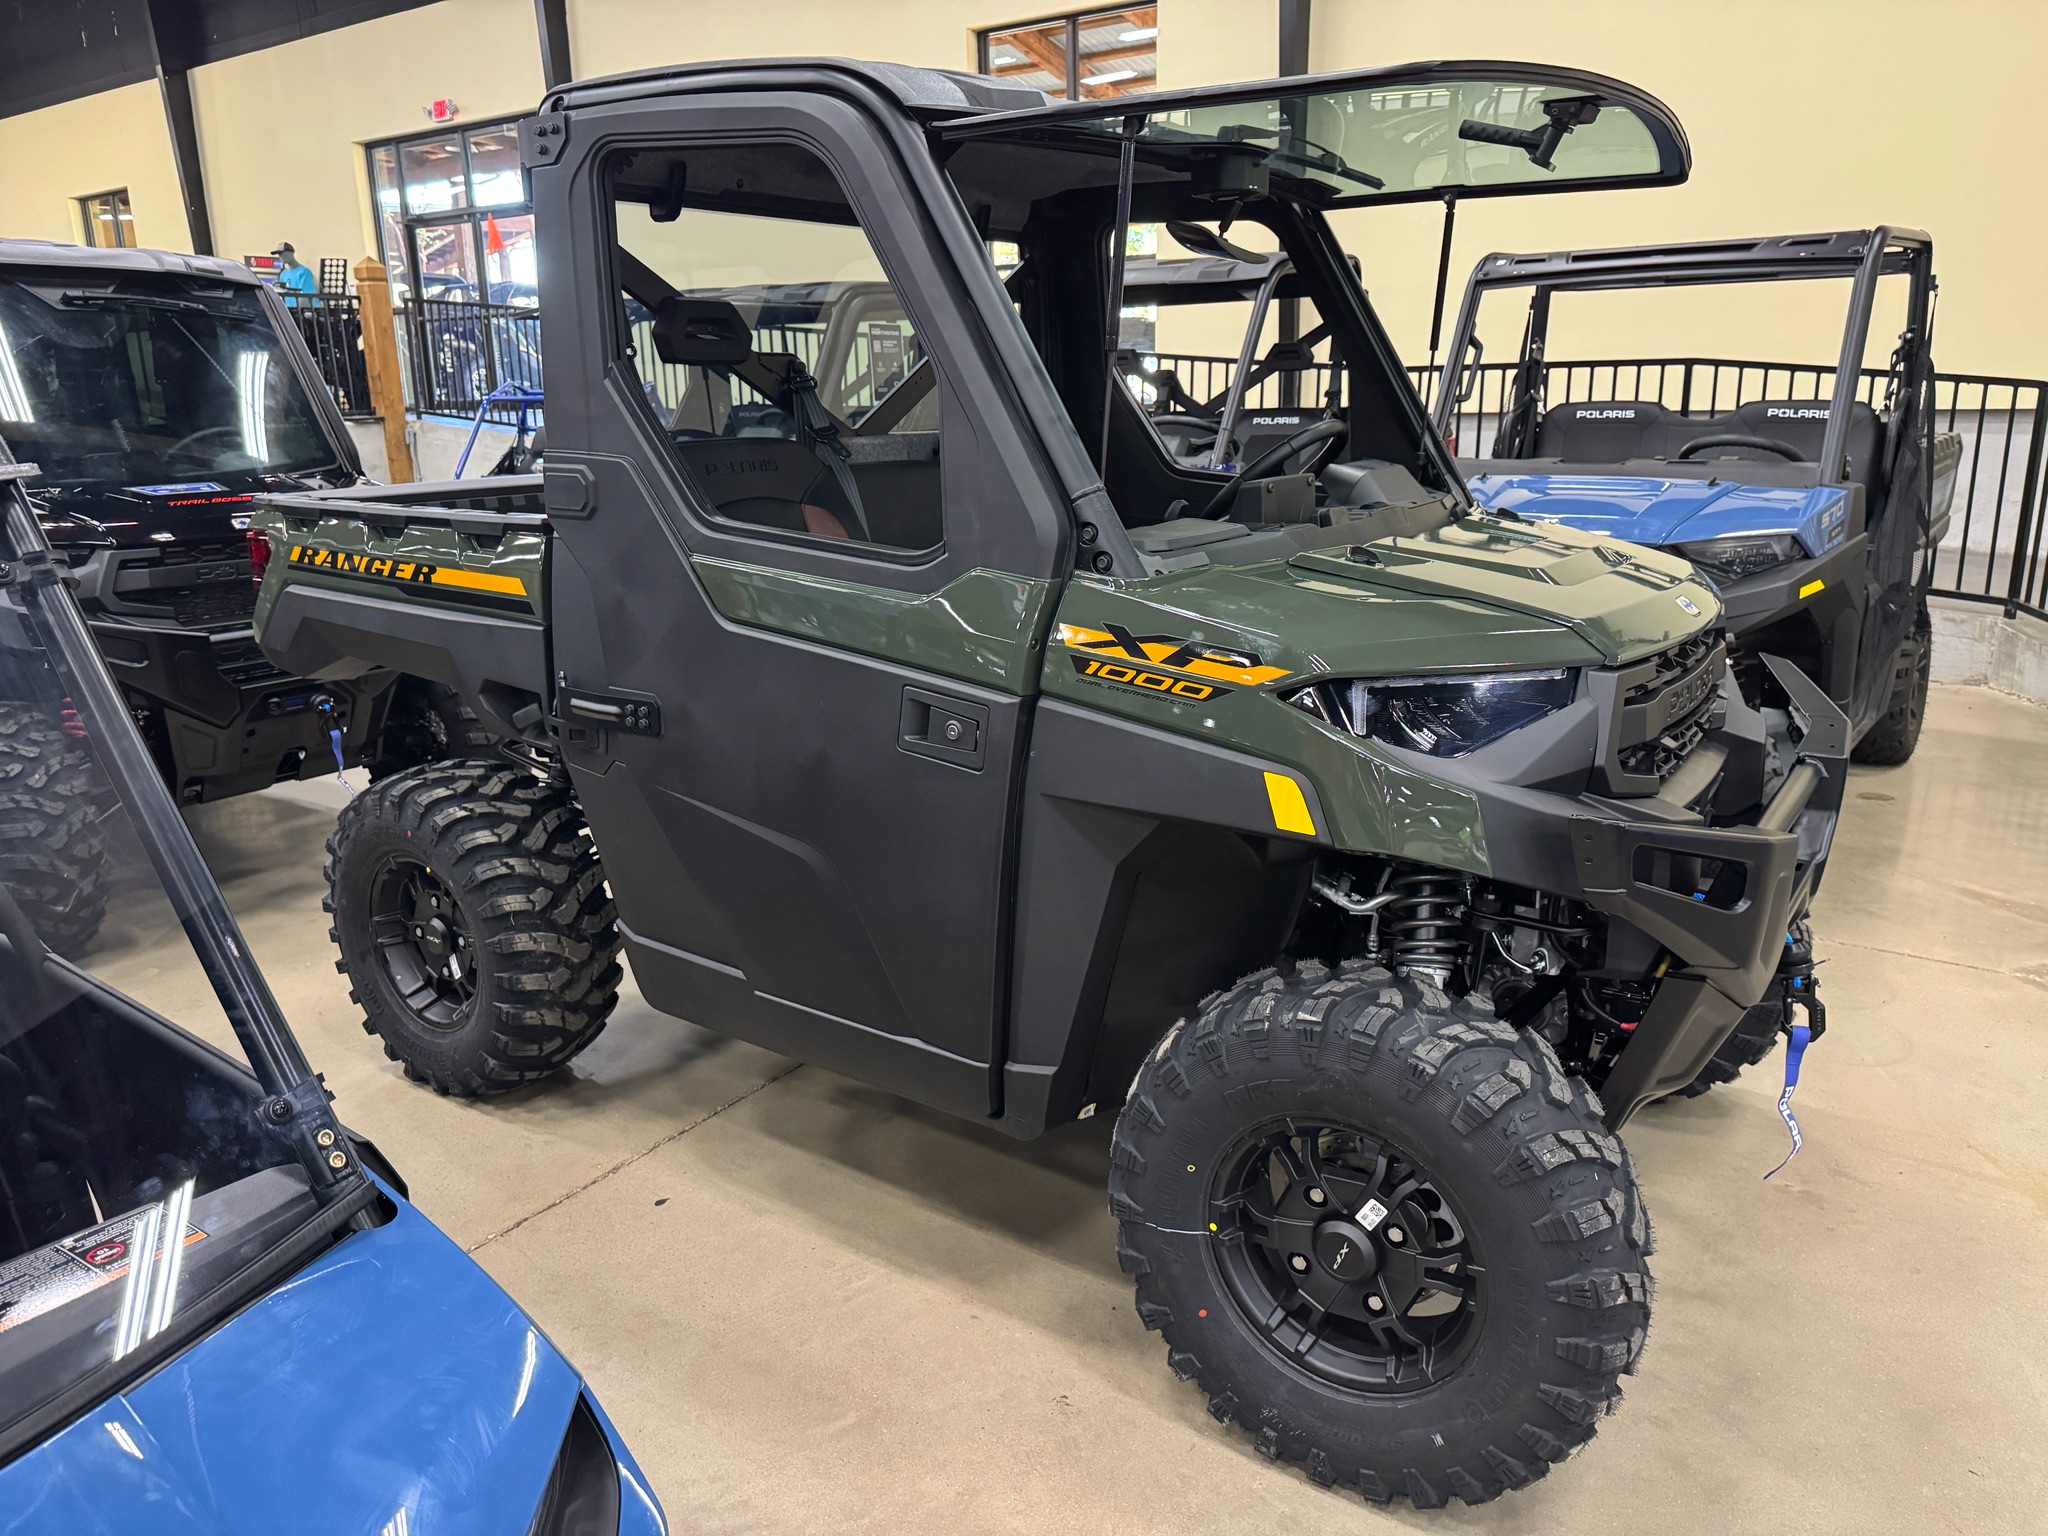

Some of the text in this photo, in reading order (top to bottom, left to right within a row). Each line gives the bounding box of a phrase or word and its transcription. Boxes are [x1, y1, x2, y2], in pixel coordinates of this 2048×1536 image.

[1252, 416, 1300, 425] POLARIS
[1576, 409, 1636, 419] POLARIS
[704, 459, 779, 476] POLARIS
[167, 496, 252, 507] TRAIL BOSS
[296, 546, 438, 585] RANGER
[1072, 620, 1266, 670] XP
[1076, 678, 1197, 709] DUAL OVERHEAD CAM
[1084, 660, 1214, 700] 1000
[1333, 1241, 1350, 1270] XP
